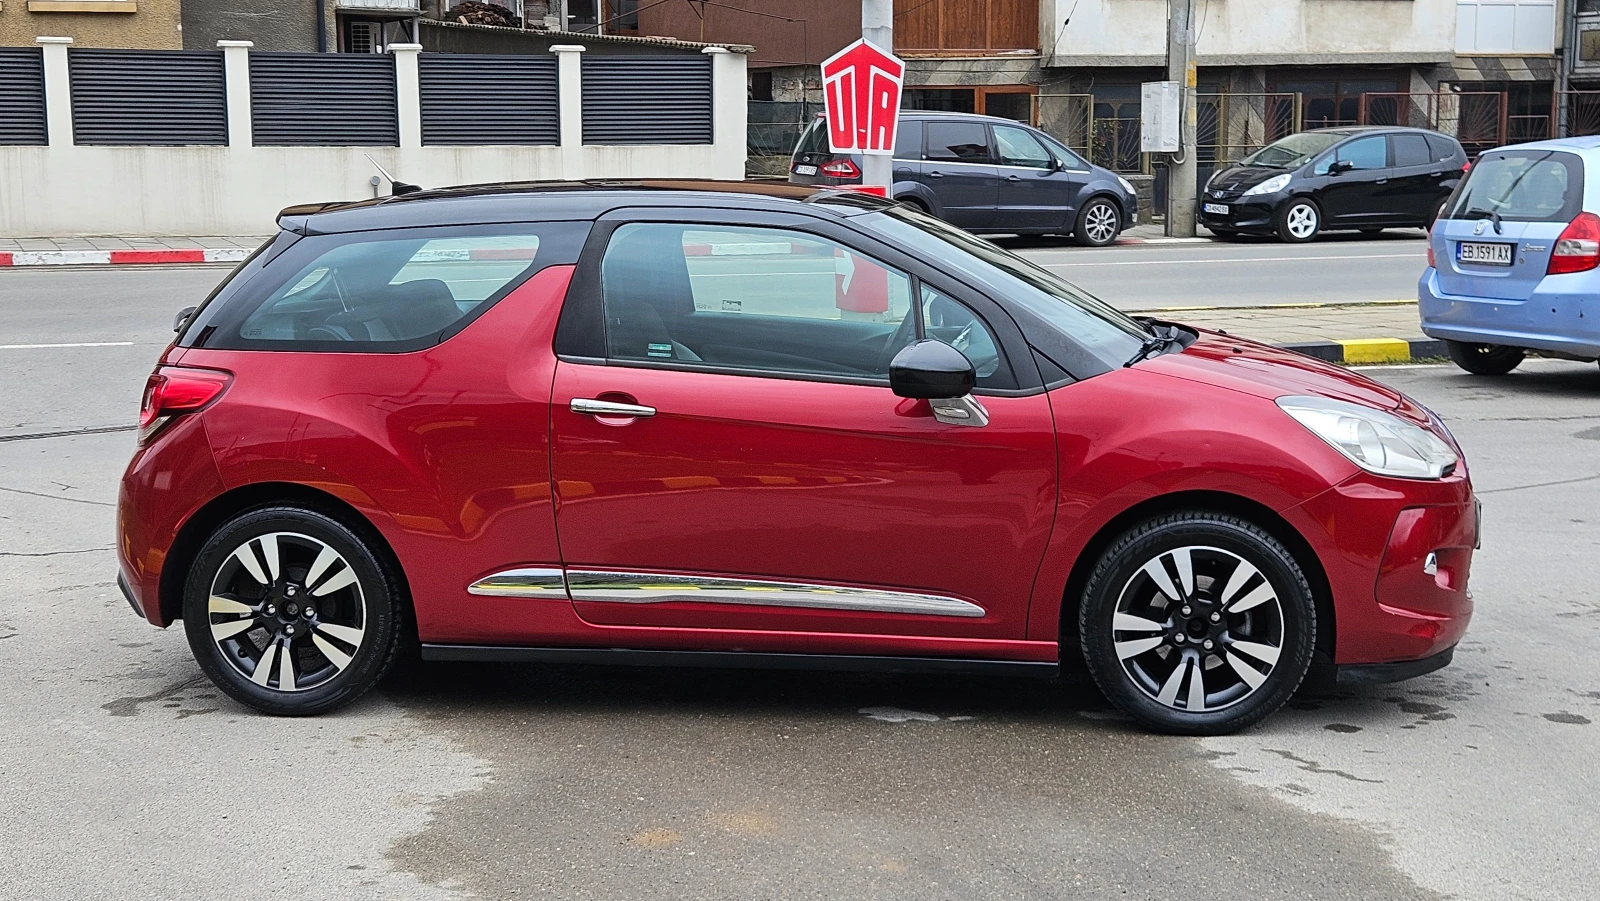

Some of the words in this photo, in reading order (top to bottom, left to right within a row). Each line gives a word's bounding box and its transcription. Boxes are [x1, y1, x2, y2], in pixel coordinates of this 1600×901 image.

[1462, 245, 1474, 259] EB
[1476, 245, 1495, 260] 1591
[1498, 246, 1509, 261] AX
